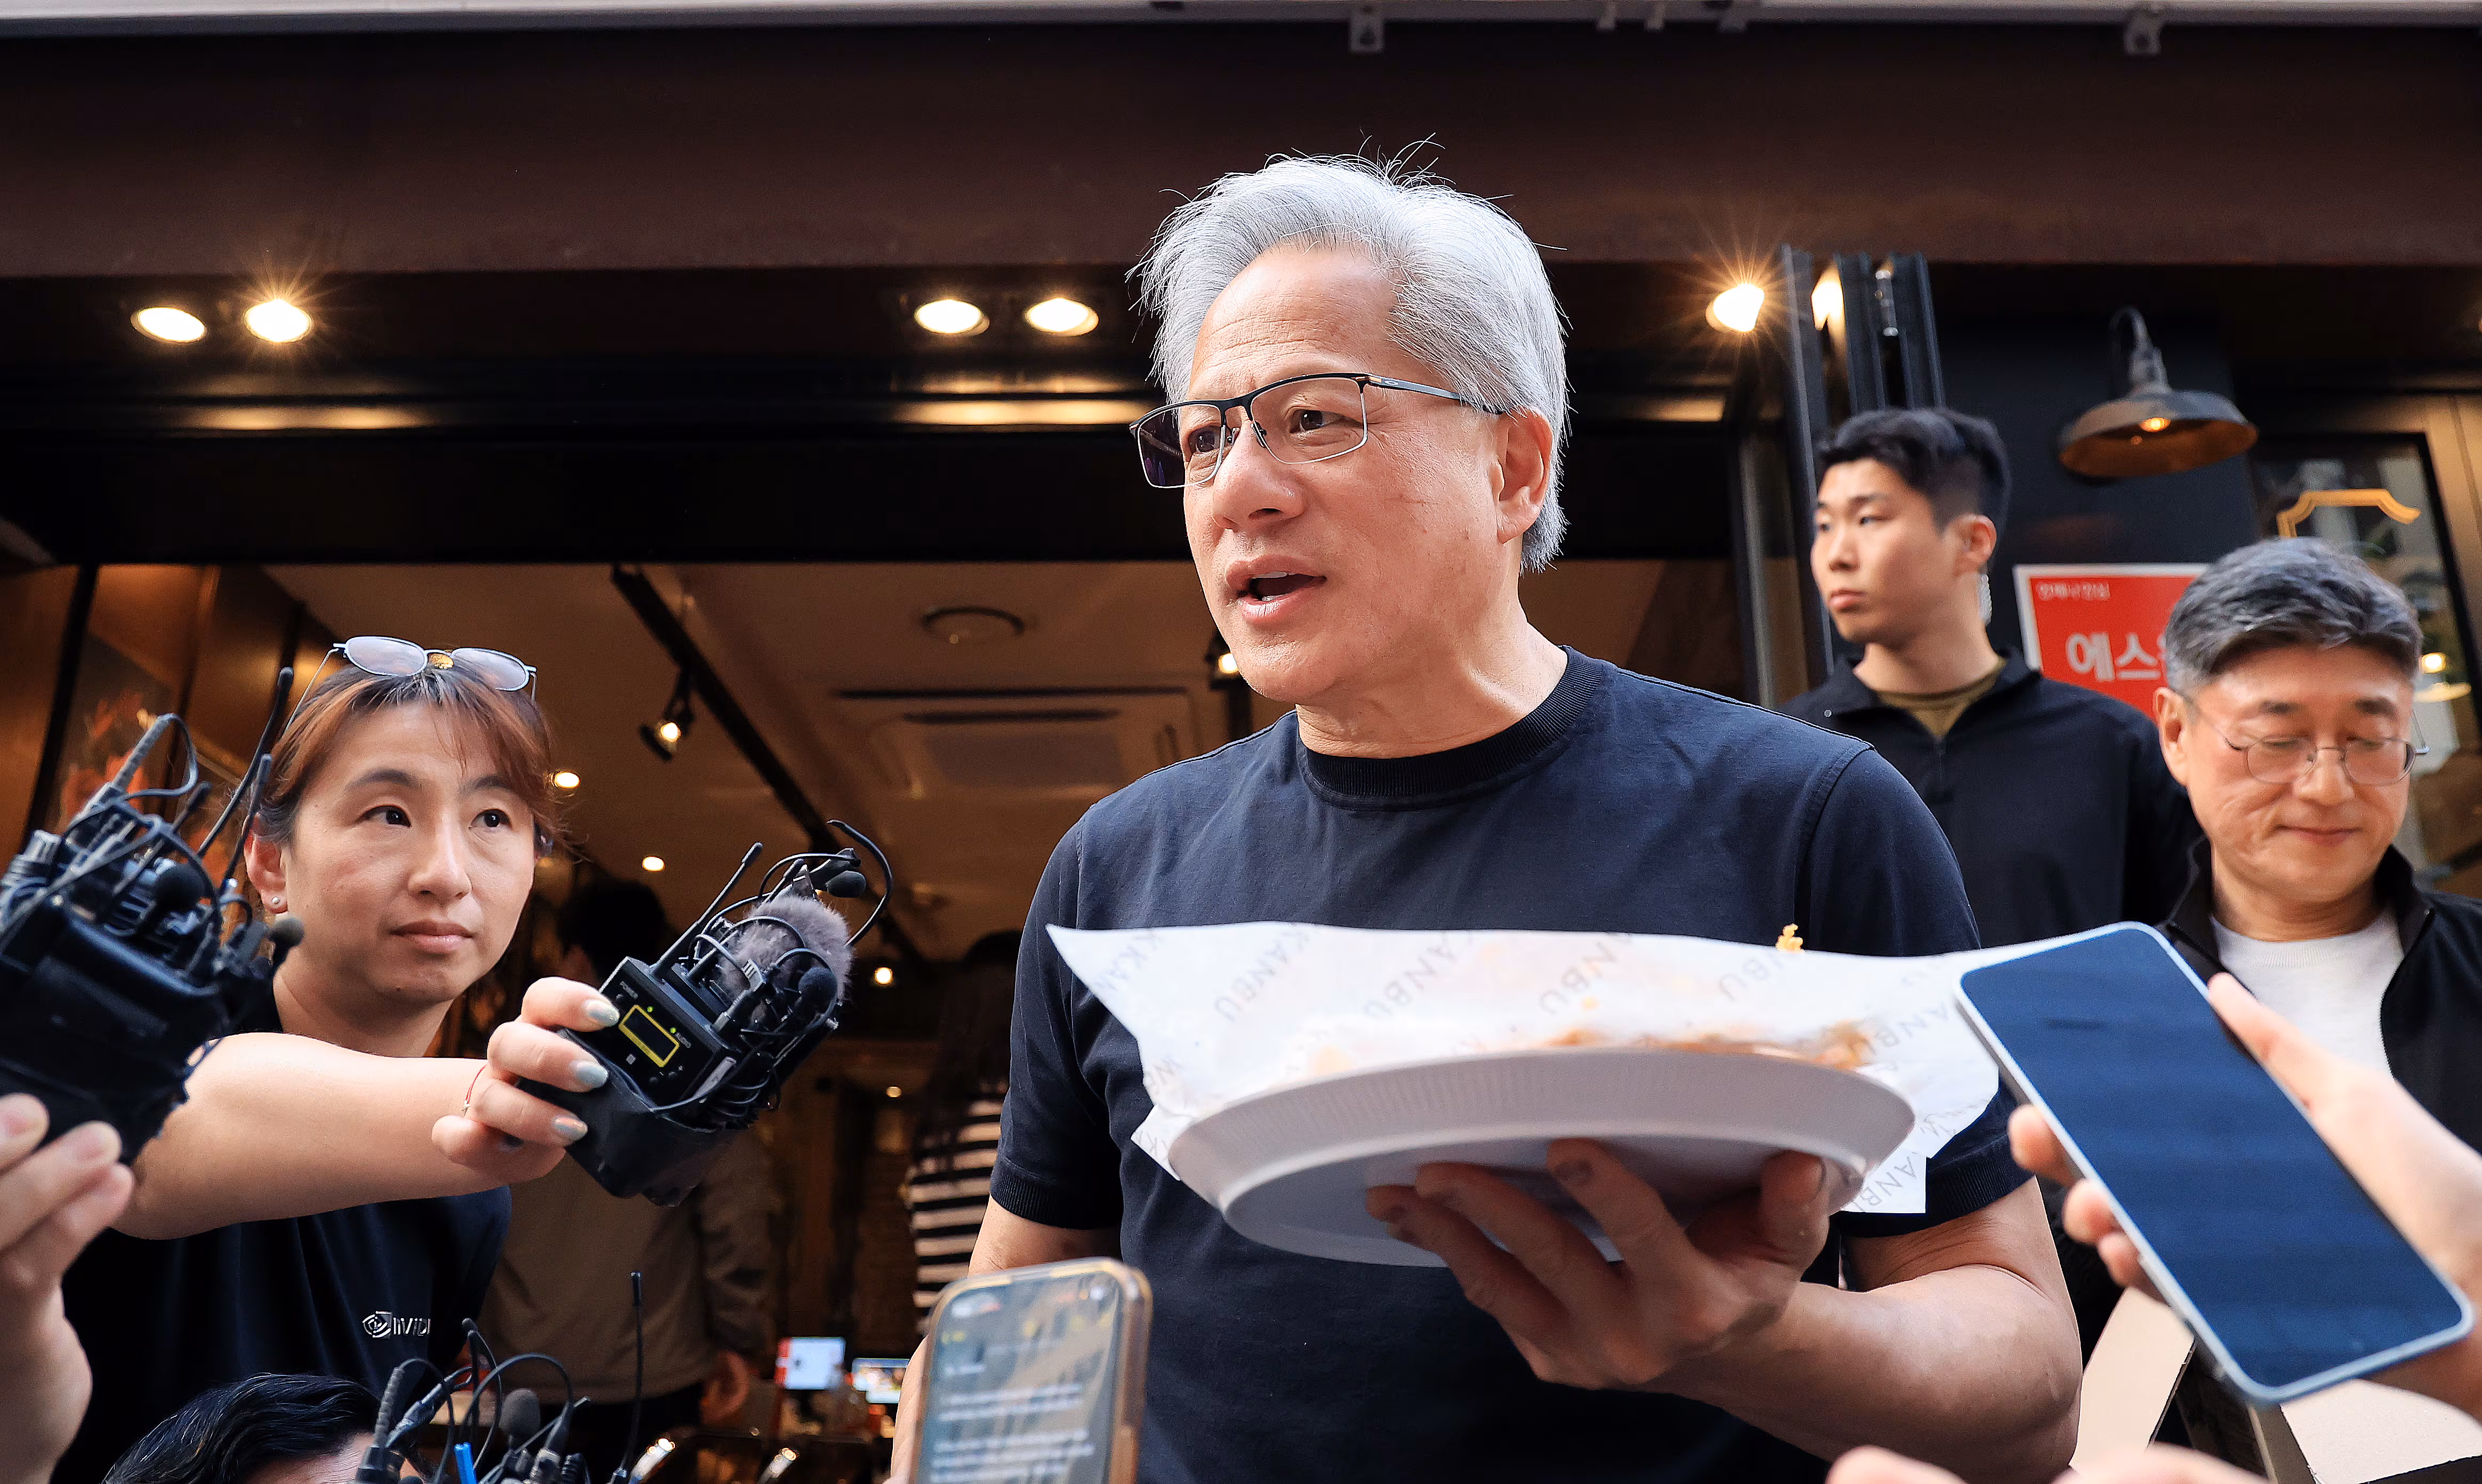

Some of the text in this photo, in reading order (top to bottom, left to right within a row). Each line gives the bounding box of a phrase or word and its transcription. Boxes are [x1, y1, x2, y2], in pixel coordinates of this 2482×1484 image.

[2066, 633, 2167, 682] 에스
[1214, 930, 1310, 1022] KANBU
[1363, 934, 1463, 1017] ANBU
[1854, 1152, 1918, 1212] ANB
